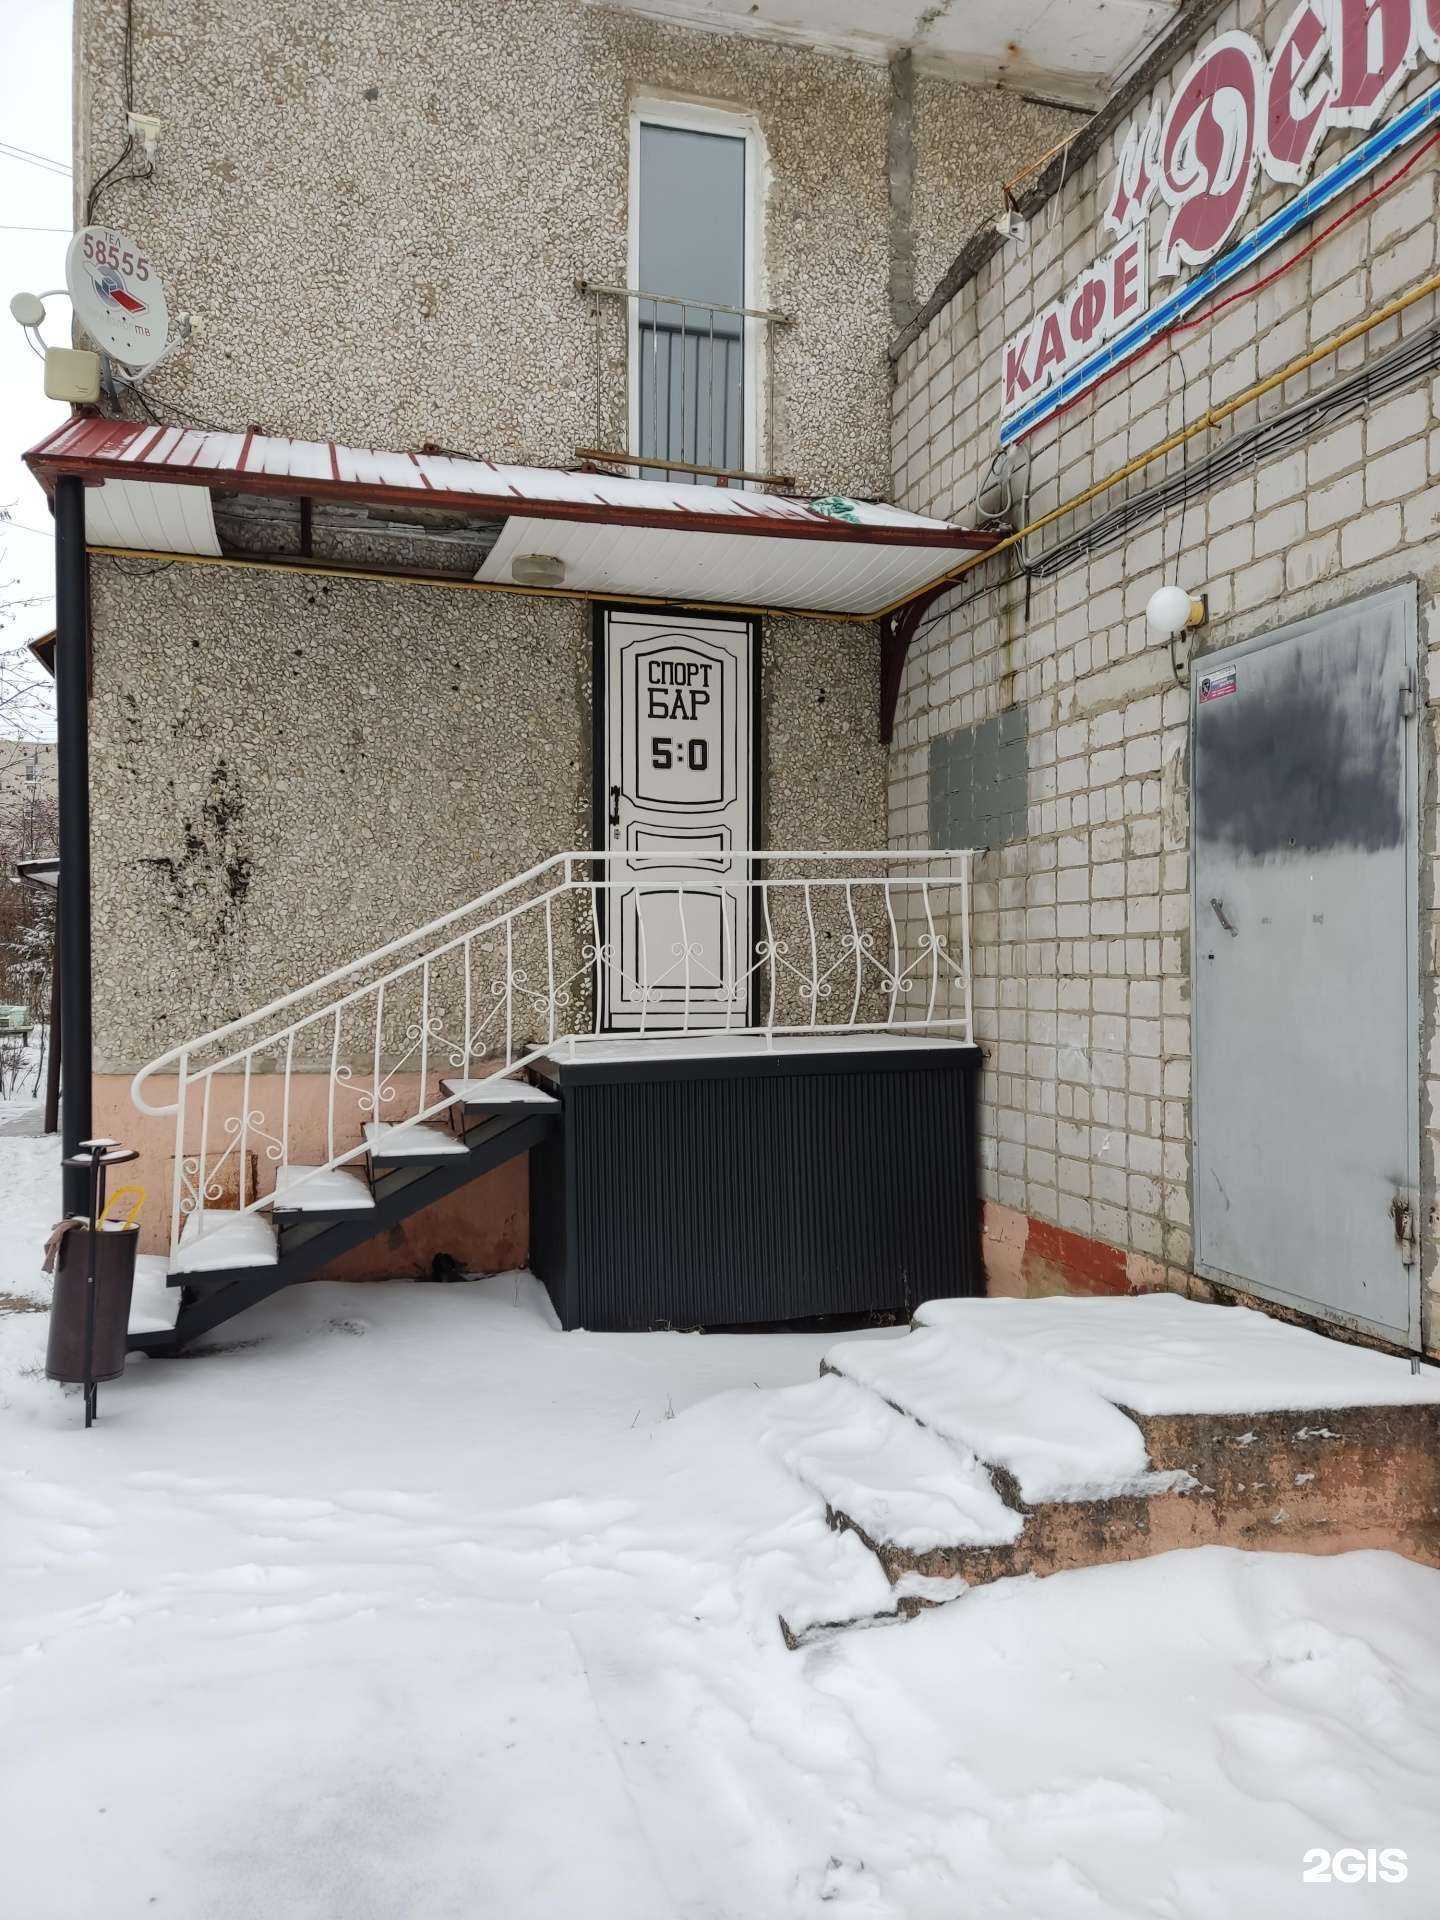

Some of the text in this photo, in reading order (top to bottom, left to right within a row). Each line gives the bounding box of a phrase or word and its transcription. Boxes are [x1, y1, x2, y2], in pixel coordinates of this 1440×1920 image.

[83, 233, 149, 281] 58555
[1005, 240, 1139, 400] КАФЕ
[649, 660, 712, 687] СПОРТ
[648, 688, 710, 720] БАР
[653, 738, 707, 770] 5:0
